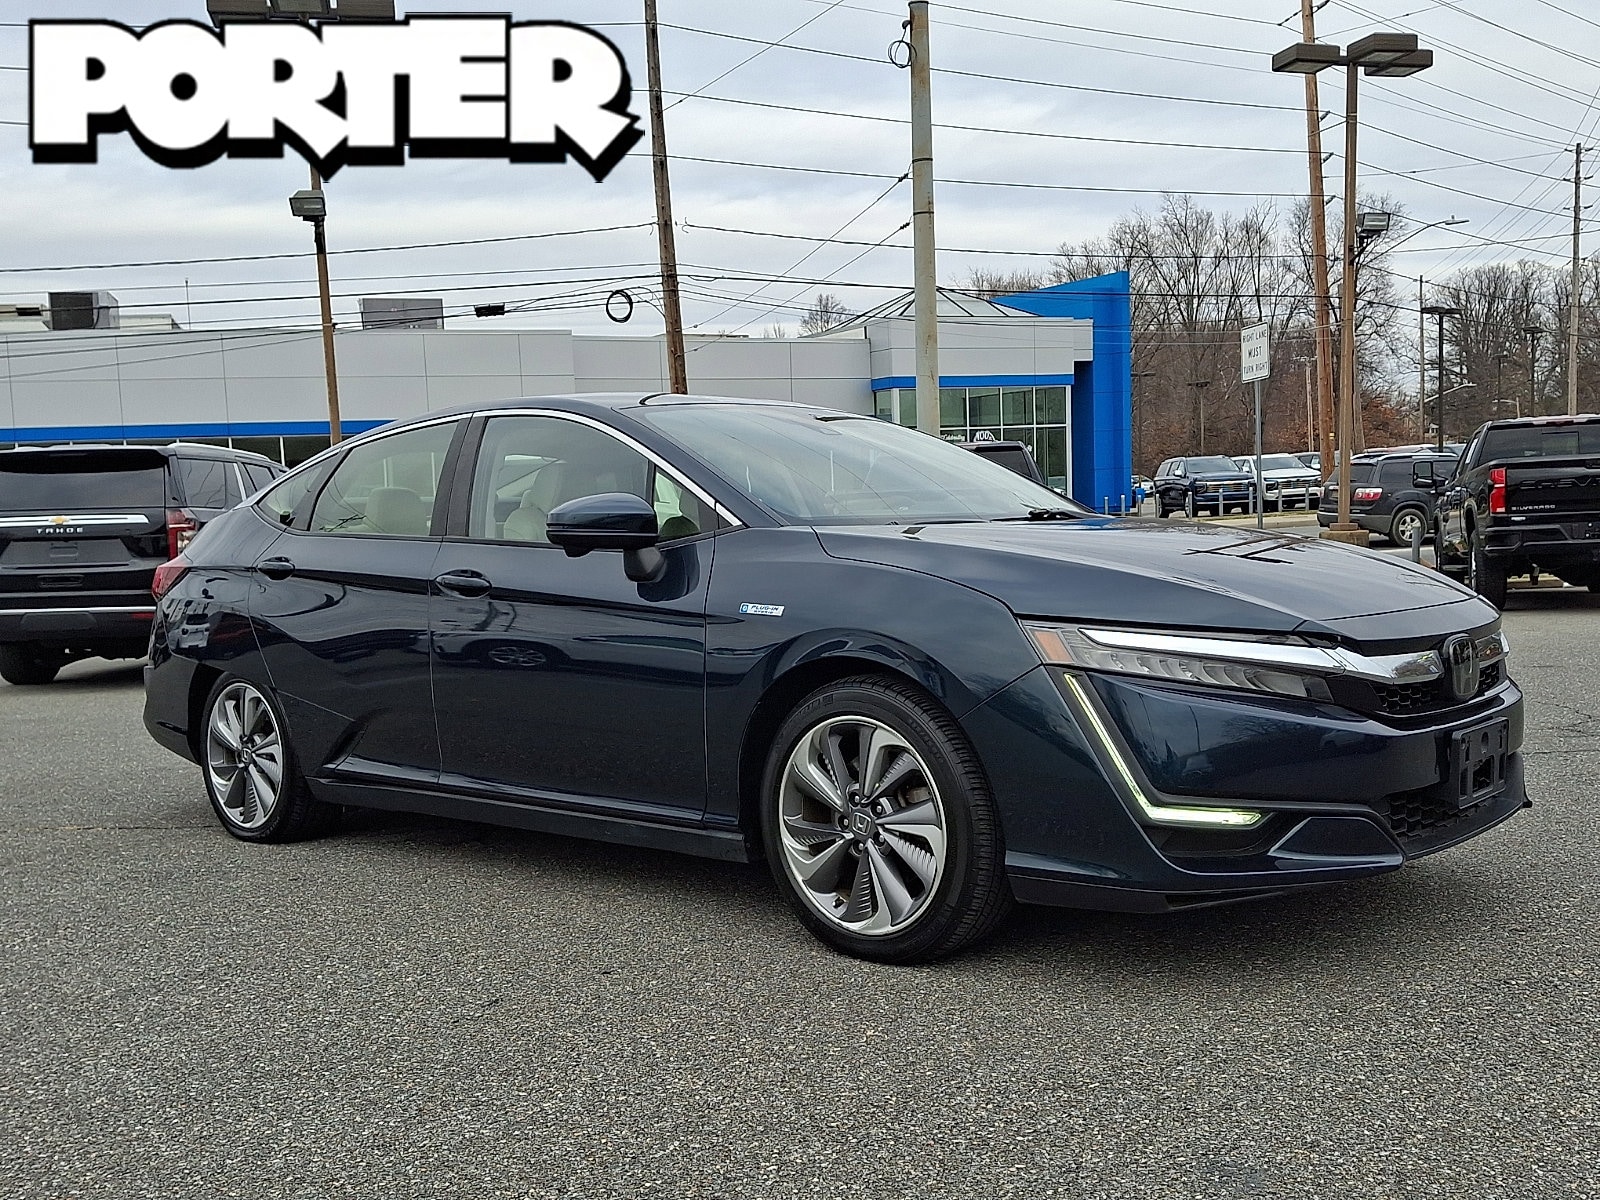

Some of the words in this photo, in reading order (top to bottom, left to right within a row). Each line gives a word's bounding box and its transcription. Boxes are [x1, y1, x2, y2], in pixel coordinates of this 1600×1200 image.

[1242, 332, 1255, 343] RIGHT
[1255, 329, 1267, 340] LANE
[1247, 345, 1262, 358] MUST
[1243, 365, 1254, 374] TURN
[1255, 361, 1268, 371] RIGHT
